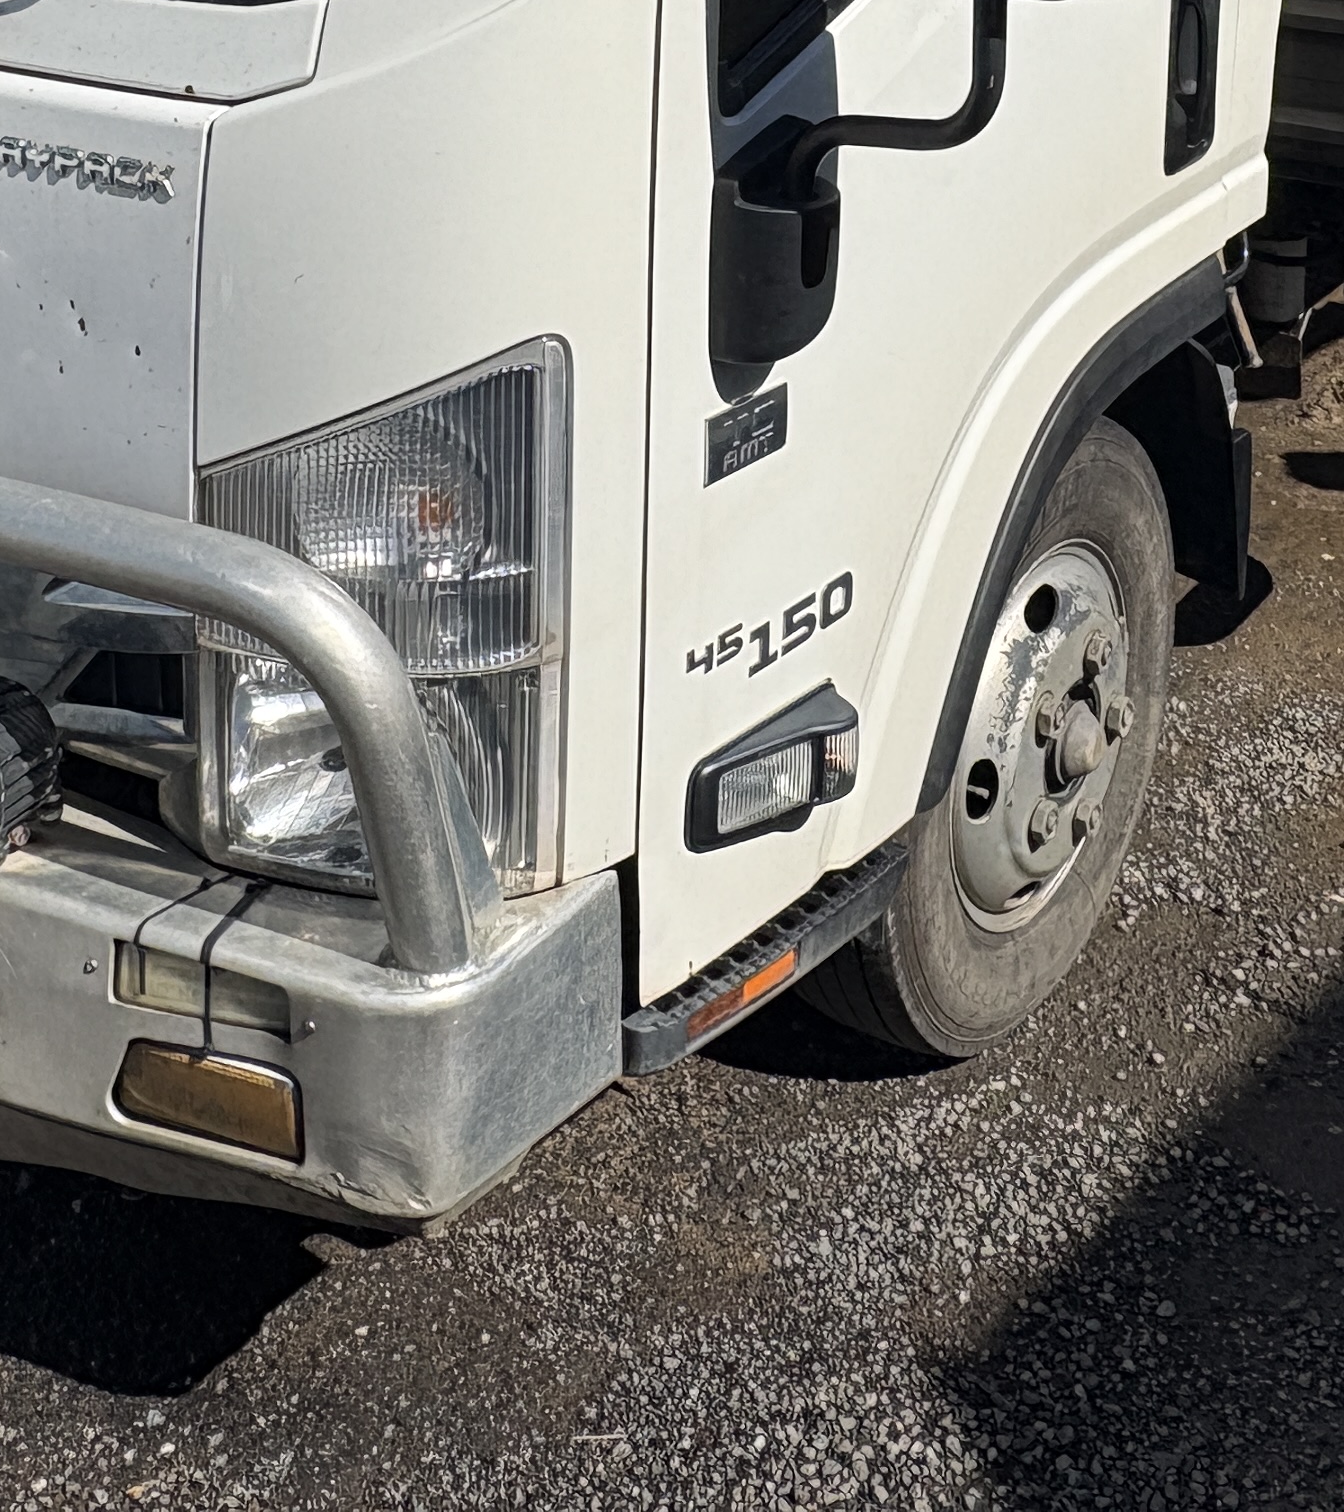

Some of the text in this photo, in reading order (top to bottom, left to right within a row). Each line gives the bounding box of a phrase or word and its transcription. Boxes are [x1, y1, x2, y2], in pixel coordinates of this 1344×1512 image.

[722, 432, 774, 473] AMT
[685, 570, 854, 679] 45 150
